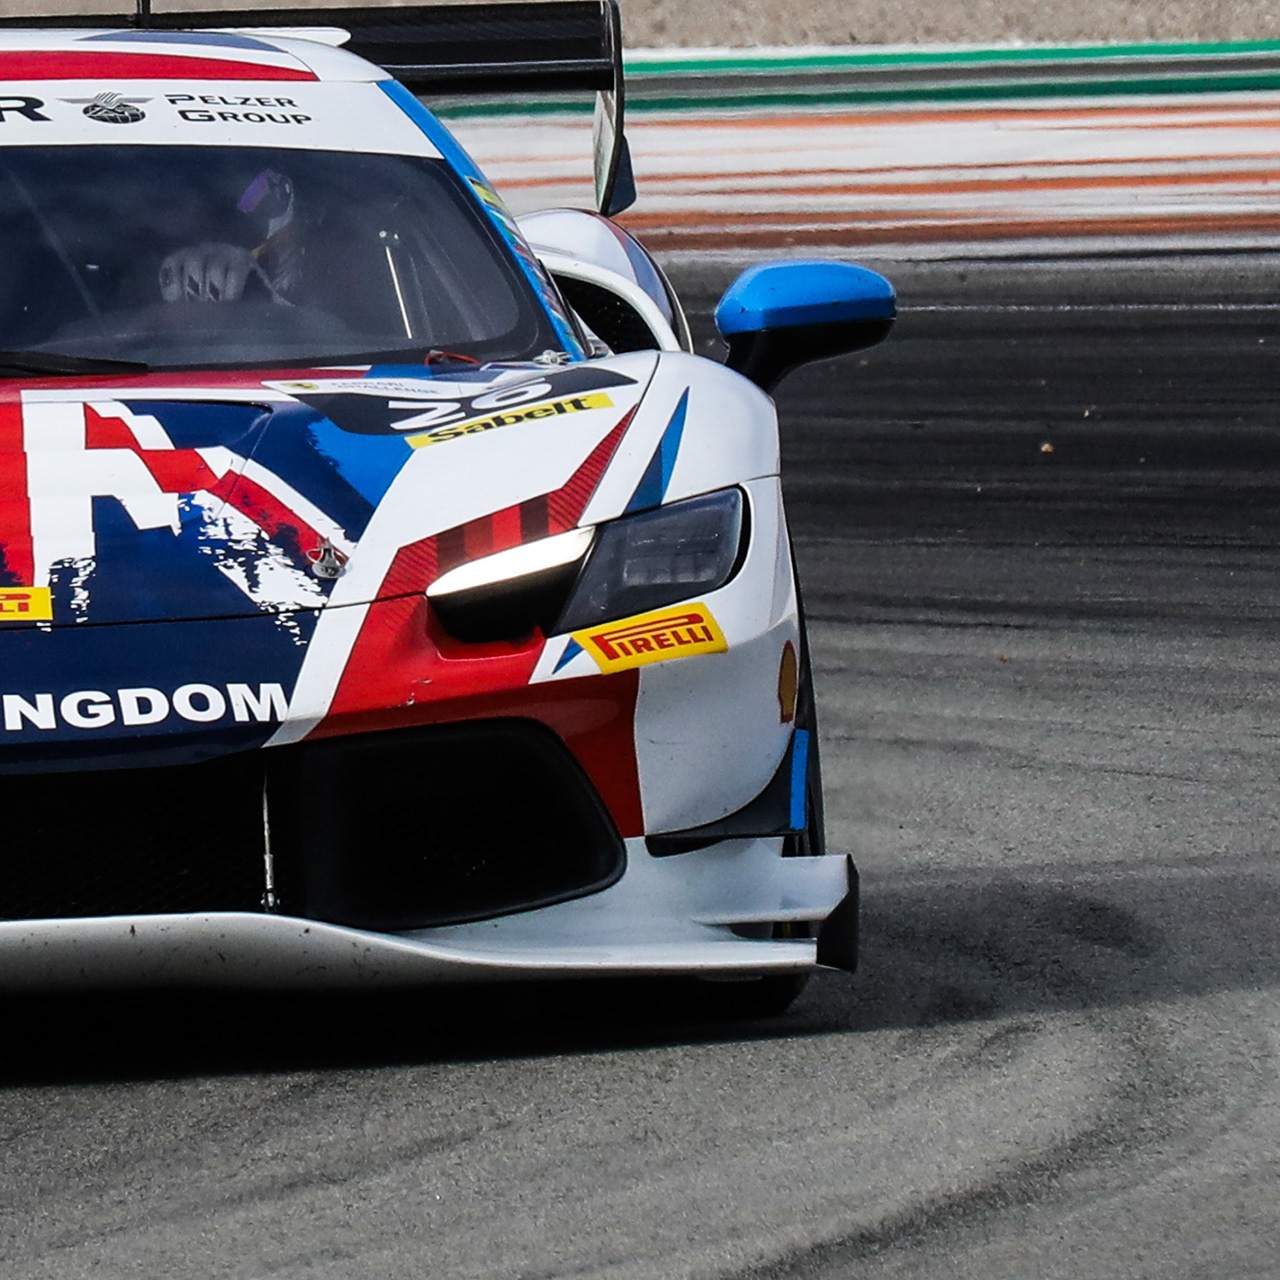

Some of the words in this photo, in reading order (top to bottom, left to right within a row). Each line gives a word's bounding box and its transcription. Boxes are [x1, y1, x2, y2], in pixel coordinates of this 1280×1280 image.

[164, 94, 299, 108] PELZER
[178, 109, 312, 125] GROUP
[388, 377, 552, 430] 26
[427, 396, 593, 443] Sabelt
[590, 613, 714, 660] PIRELLI
